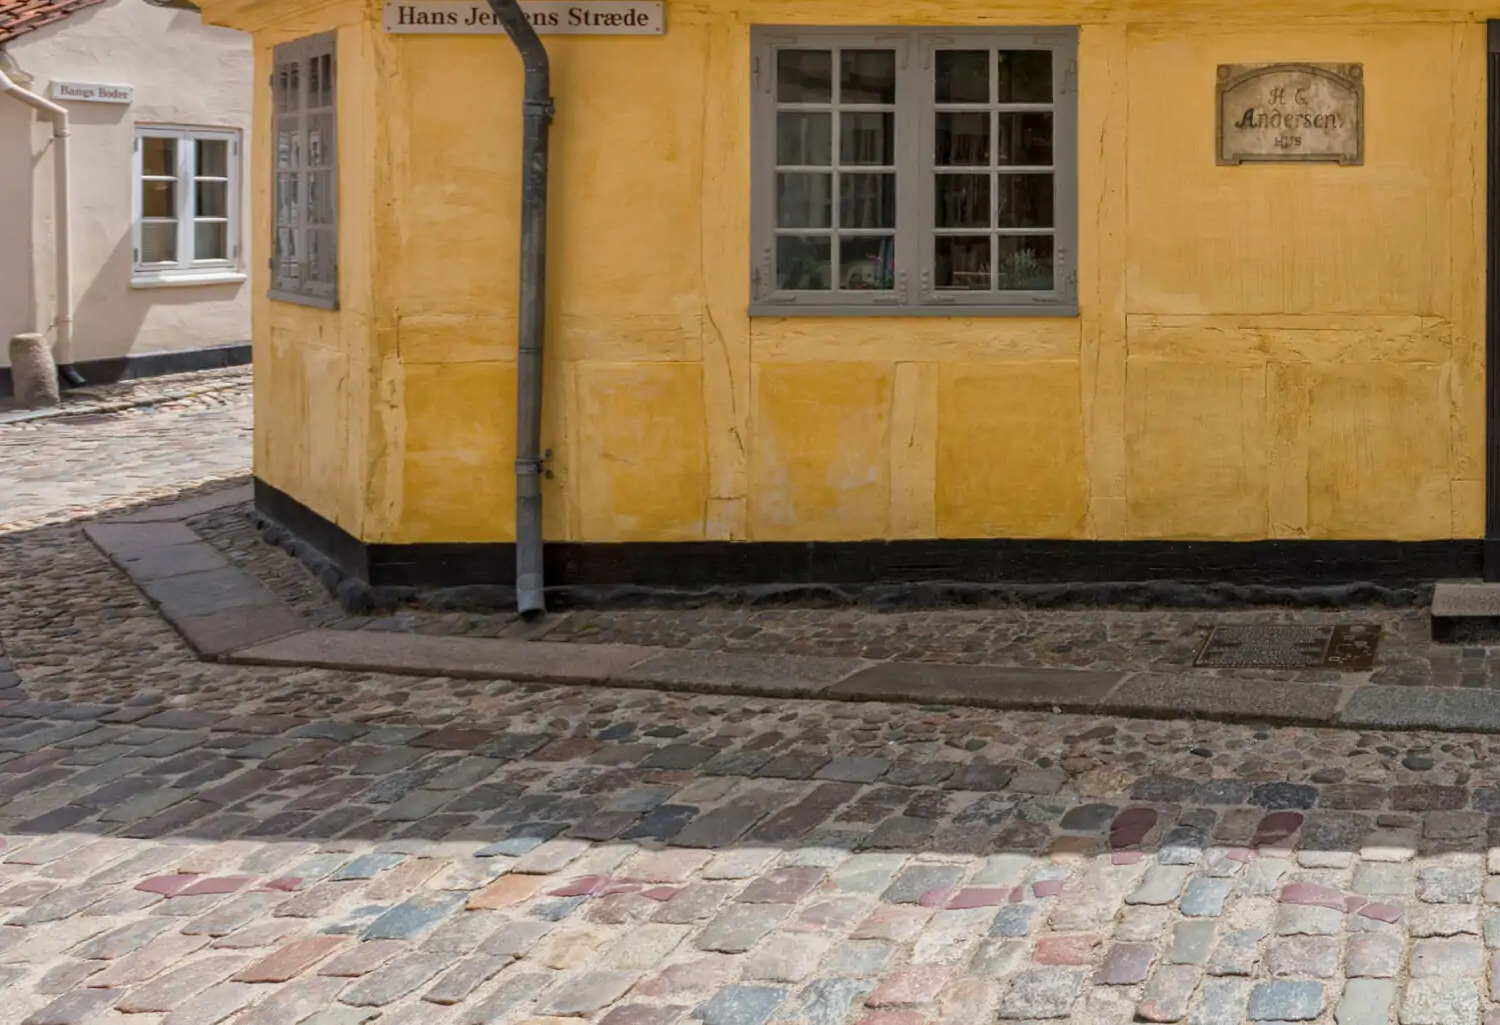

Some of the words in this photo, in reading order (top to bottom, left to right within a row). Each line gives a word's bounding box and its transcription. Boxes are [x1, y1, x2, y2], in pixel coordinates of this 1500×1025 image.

[397, 6, 458, 25] Hans
[464, 7, 559, 26] Jeens
[568, 6, 650, 27] Stræde
[60, 84, 95, 98] Bangs
